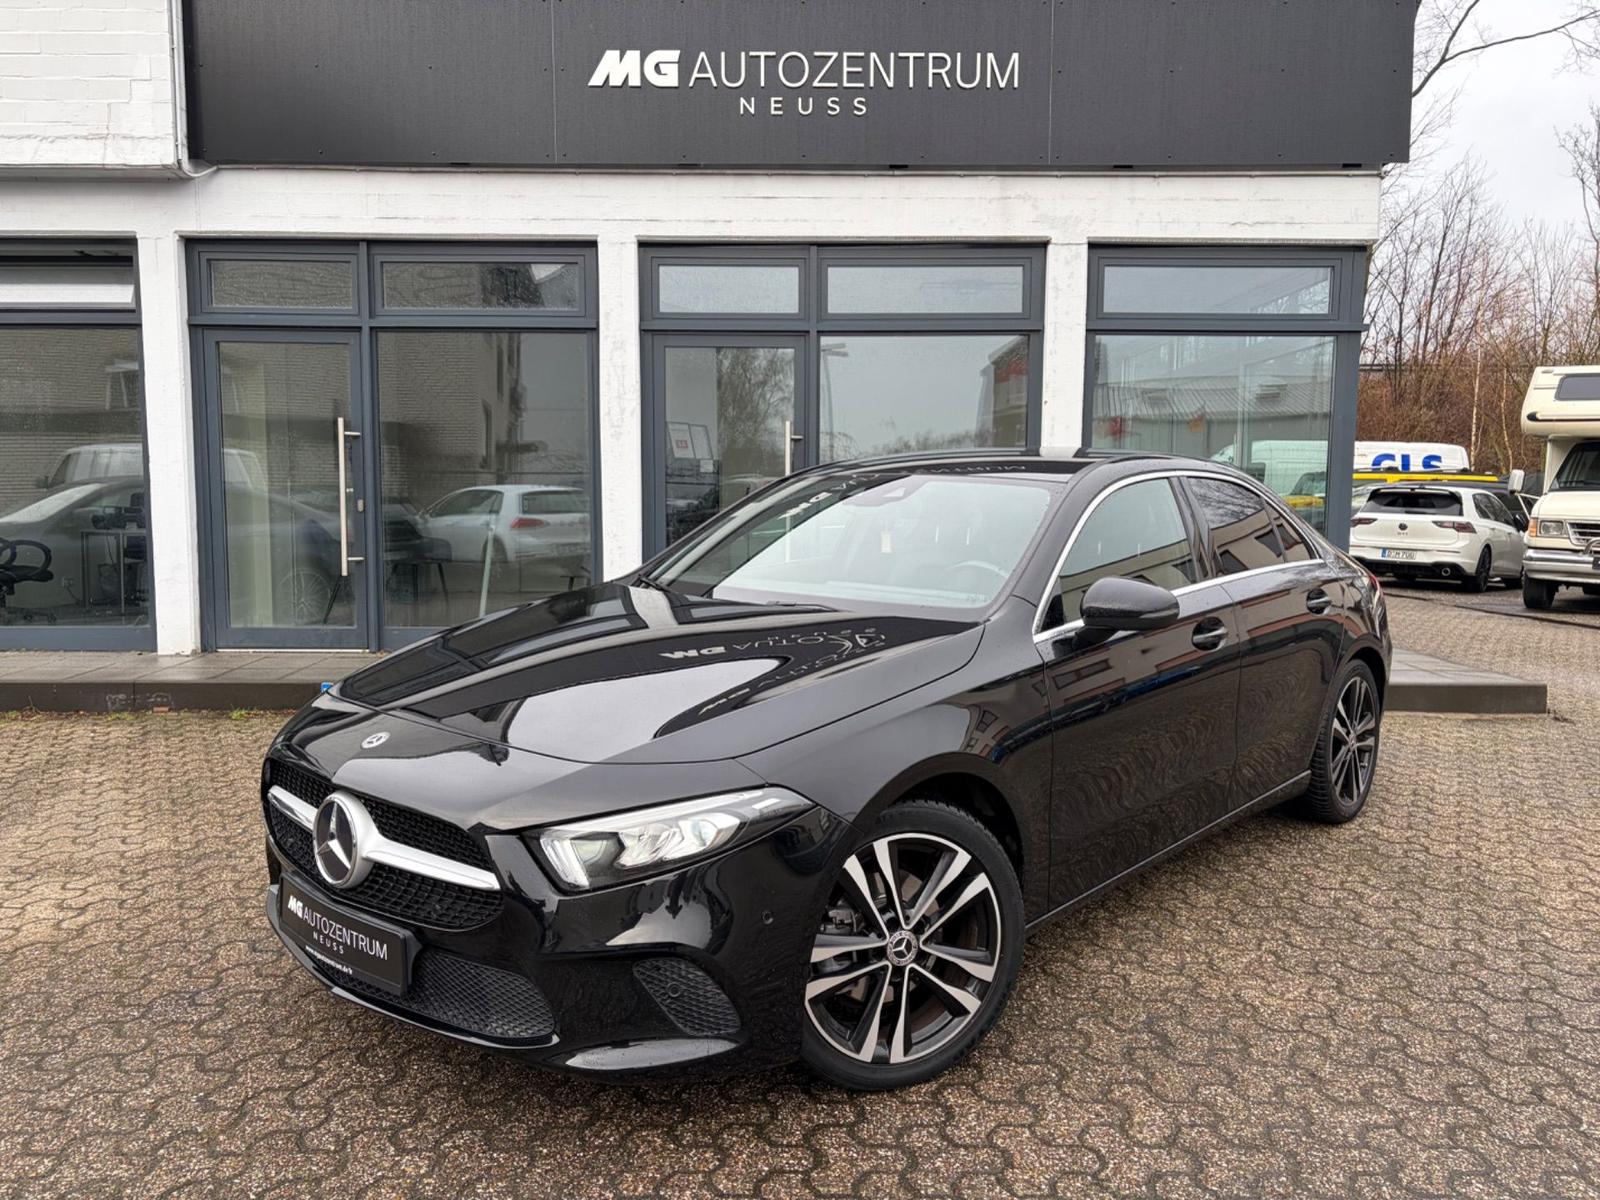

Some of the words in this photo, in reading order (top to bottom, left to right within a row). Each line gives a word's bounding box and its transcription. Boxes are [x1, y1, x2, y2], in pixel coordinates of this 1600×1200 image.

[587, 49, 681, 88] MG
[688, 50, 1020, 89] AUTOZENTRUM
[739, 96, 868, 116] NEUSS
[288, 895, 303, 919] MG
[303, 908, 388, 960] AUTOZENTRUM
[313, 931, 344, 954] NEUSS
